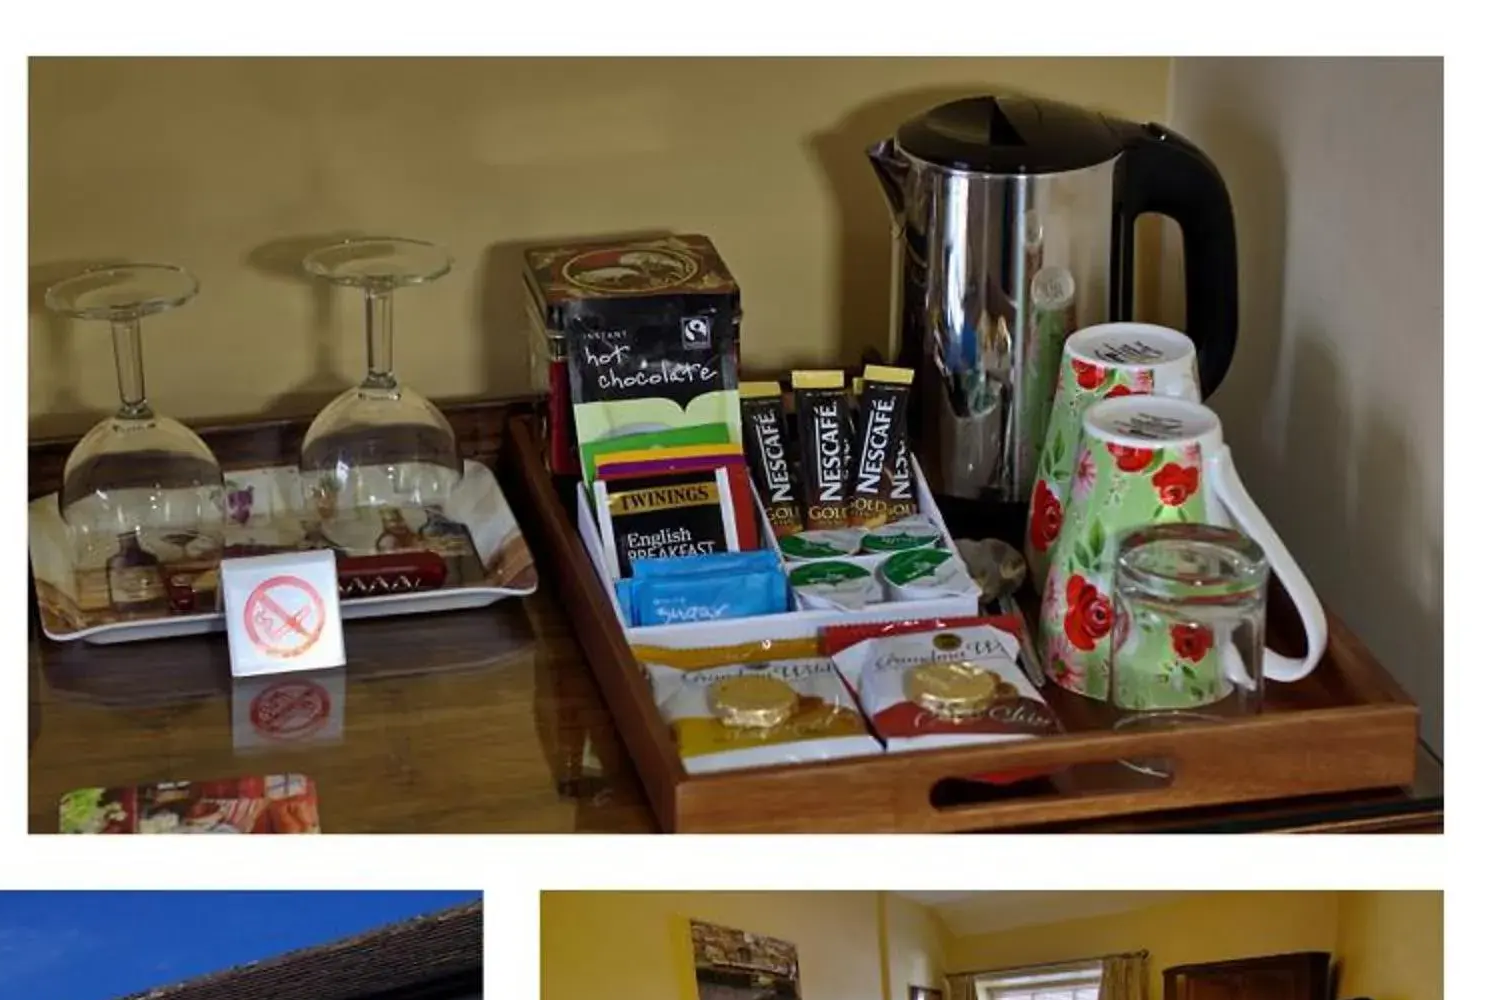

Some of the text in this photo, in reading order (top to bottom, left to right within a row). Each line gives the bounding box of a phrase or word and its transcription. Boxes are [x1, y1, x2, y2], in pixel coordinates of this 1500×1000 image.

[584, 344, 631, 367] hot
[598, 359, 719, 389] chocolate
[752, 409, 794, 502] NESCAFÉ
[814, 401, 843, 502] NESCAFÉ
[856, 396, 896, 494] NESCAFÉ
[621, 484, 710, 511] TWININGS
[626, 526, 692, 551] English
